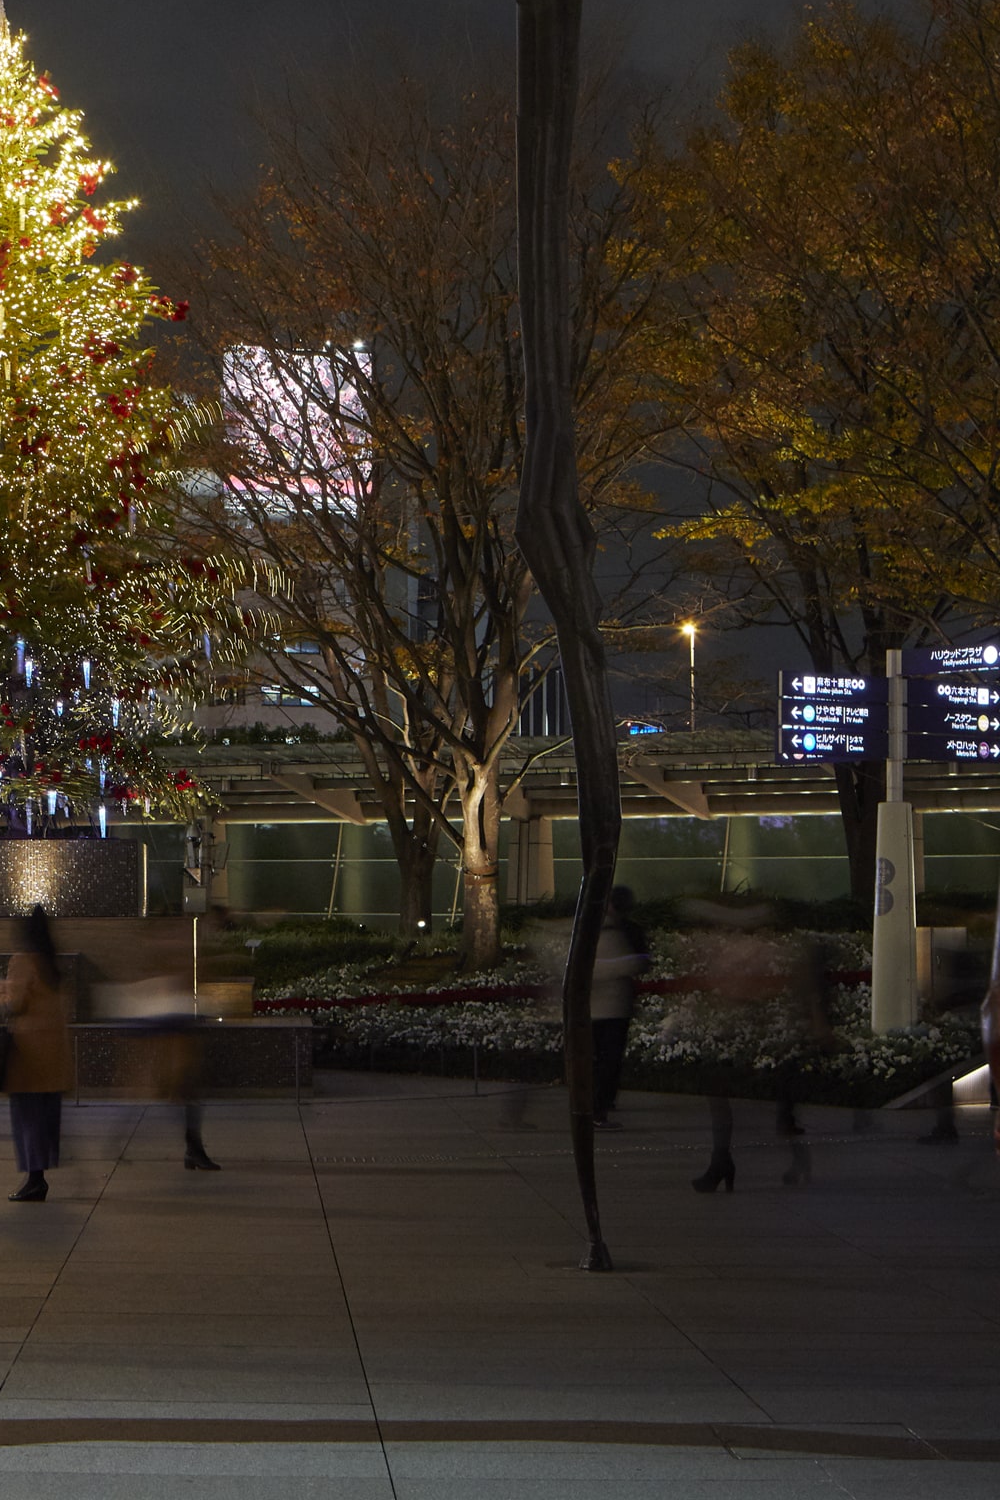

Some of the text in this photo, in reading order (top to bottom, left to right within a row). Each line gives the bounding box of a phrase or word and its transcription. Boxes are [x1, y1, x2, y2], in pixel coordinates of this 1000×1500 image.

[930, 647, 982, 660] ハリウッドプラザ
[942, 657, 982, 668] Hollywood Plaza
[816, 677, 851, 687] 麻布十番駅
[952, 687, 977, 696] 六本木駅
[948, 696, 968, 704] Roppongi
[816, 705, 842, 716] けやき坂
[846, 708, 868, 716] テレビ朝日
[944, 713, 977, 722] ノースタワー
[951, 722, 965, 730] North
[816, 734, 846, 744] ヒルサイド
[849, 736, 864, 744] シネマ
[816, 743, 833, 751] Hillside
[946, 740, 978, 750] メトロハット
[956, 749, 969, 757] Metro
